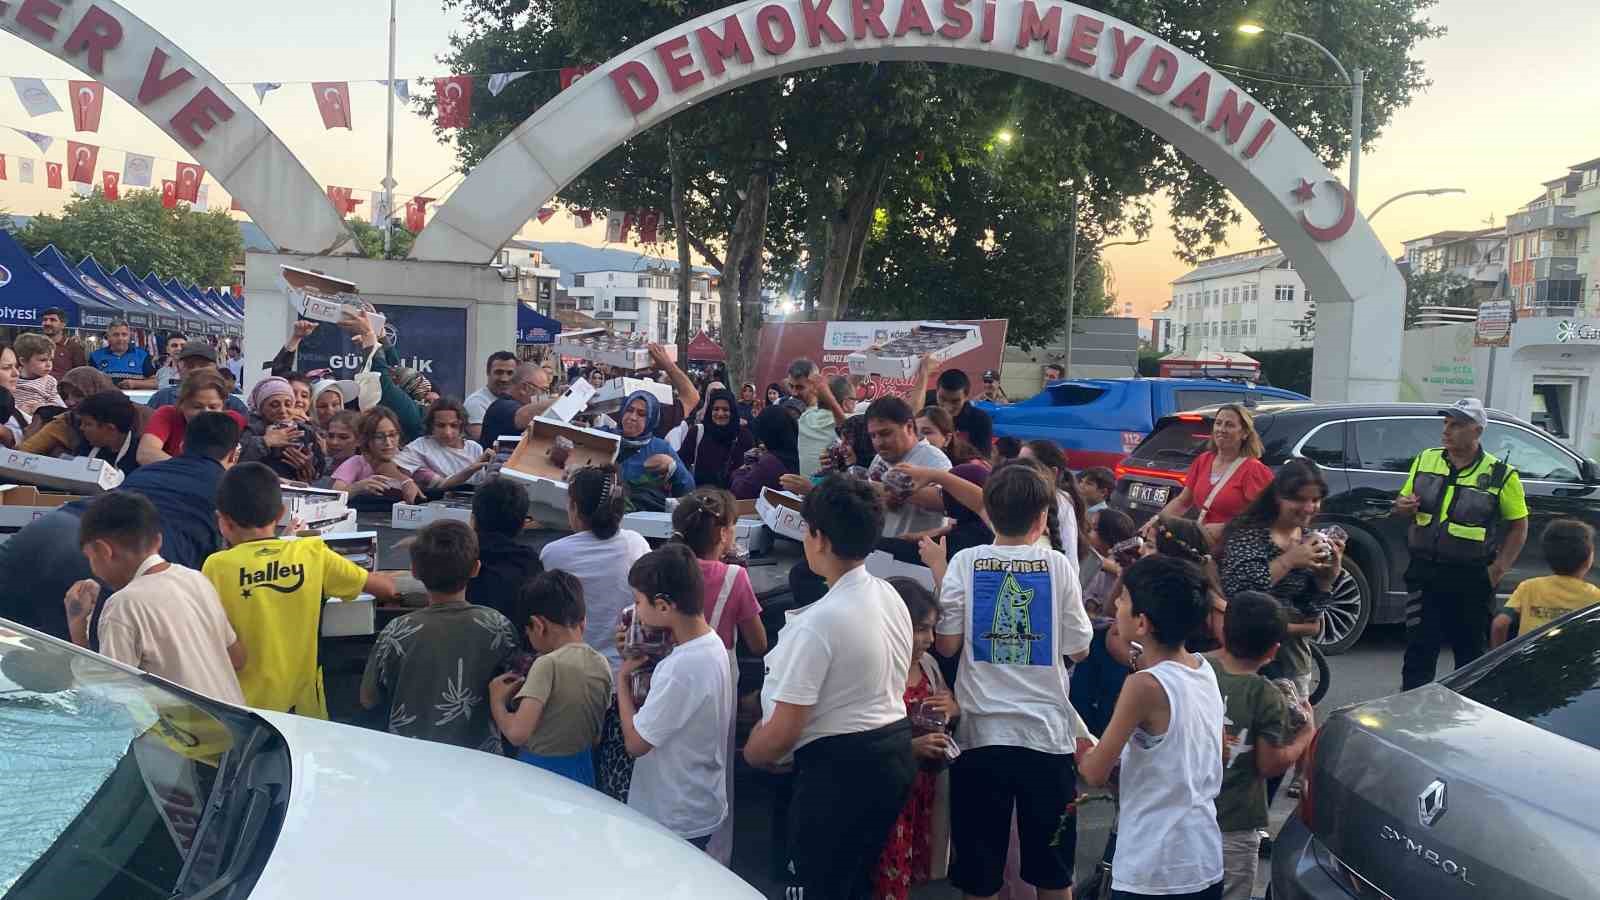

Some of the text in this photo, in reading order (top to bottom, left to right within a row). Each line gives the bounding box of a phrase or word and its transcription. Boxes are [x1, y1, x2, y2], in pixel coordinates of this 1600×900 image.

[138, 46, 237, 148] VE
[608, 0, 1276, 159] DEMOKRASİ MEYDANI
[329, 353, 433, 373] GÜLİK
[239, 560, 304, 593] halley
[974, 558, 1012, 572] SURF
[1380, 825, 1477, 887] SYMBOL
